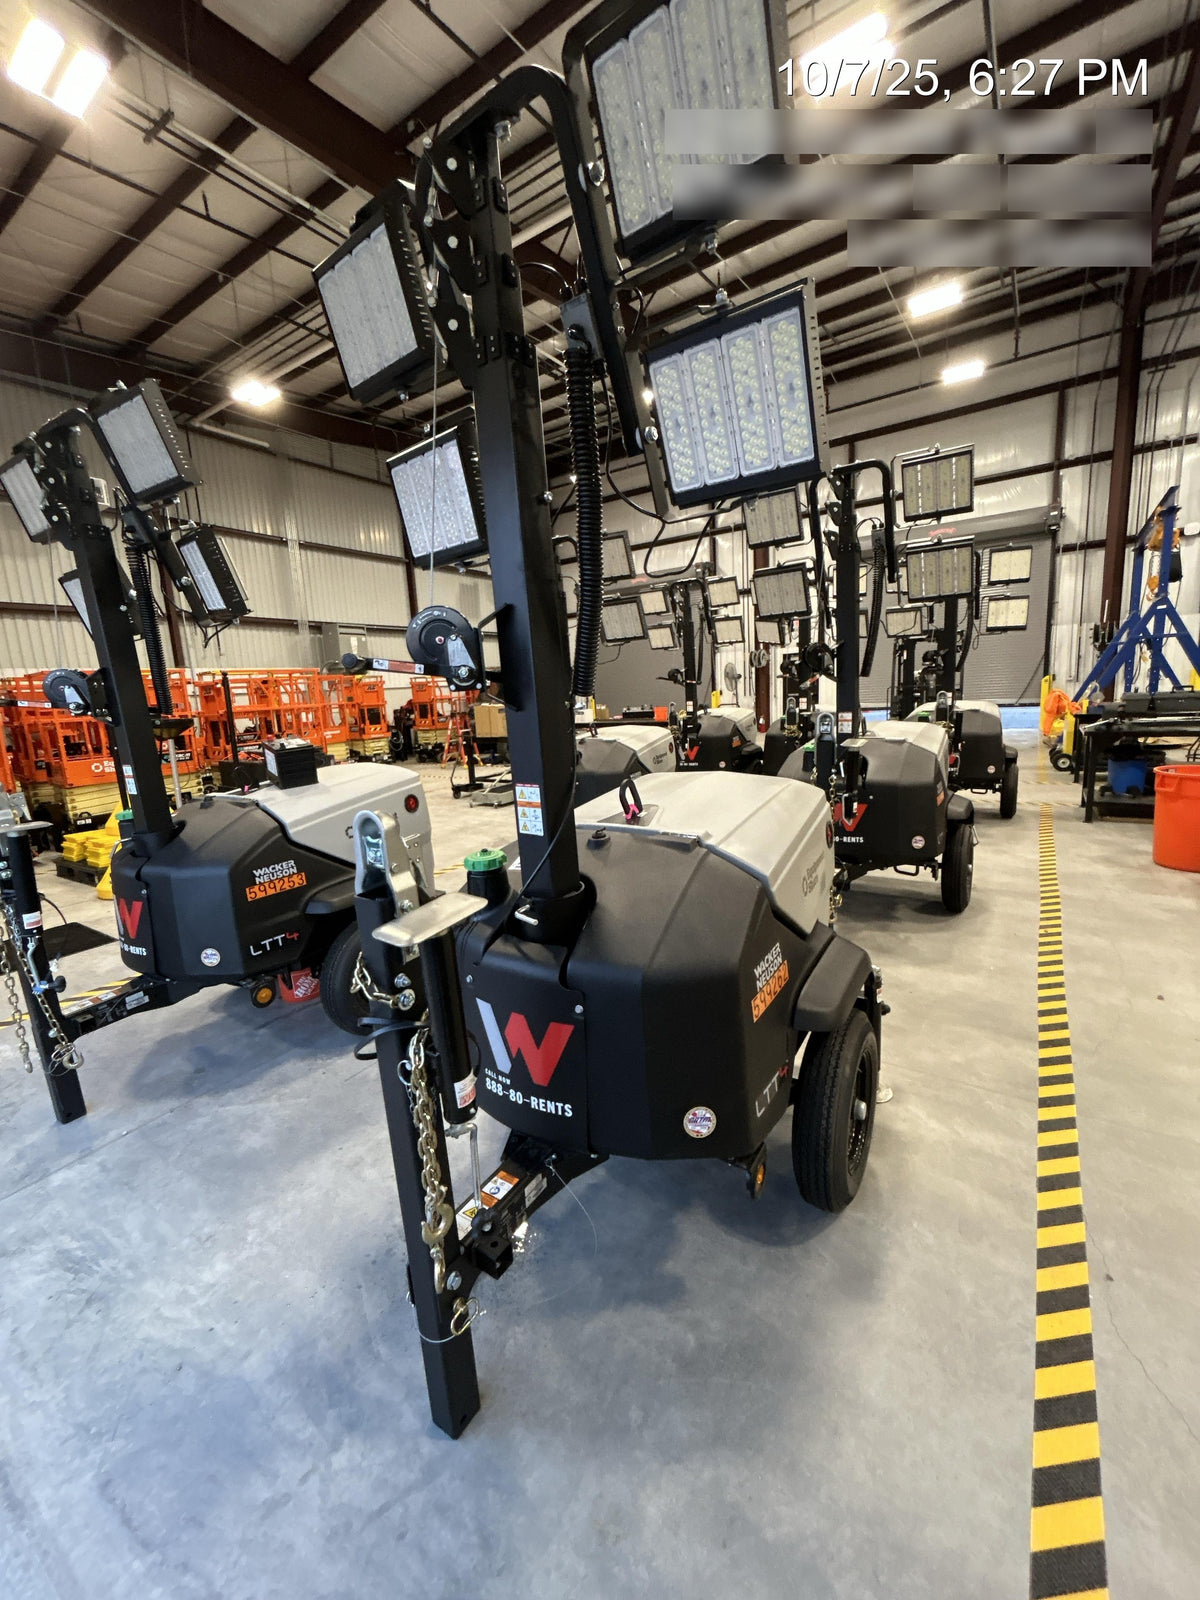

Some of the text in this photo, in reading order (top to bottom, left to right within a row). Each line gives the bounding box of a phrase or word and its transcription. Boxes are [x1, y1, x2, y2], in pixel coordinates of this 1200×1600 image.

[253, 860, 296, 877] WACKER
[255, 866, 298, 885] NEUSON
[248, 873, 305, 900] 599253
[249, 932, 300, 956] LTT4
[753, 942, 781, 978] WACKER
[756, 952, 783, 992] NEUSON
[475, 997, 575, 1087] W
[485, 1068, 512, 1086] CALL NOW
[485, 1077, 574, 1118] 888-80-RENTS
